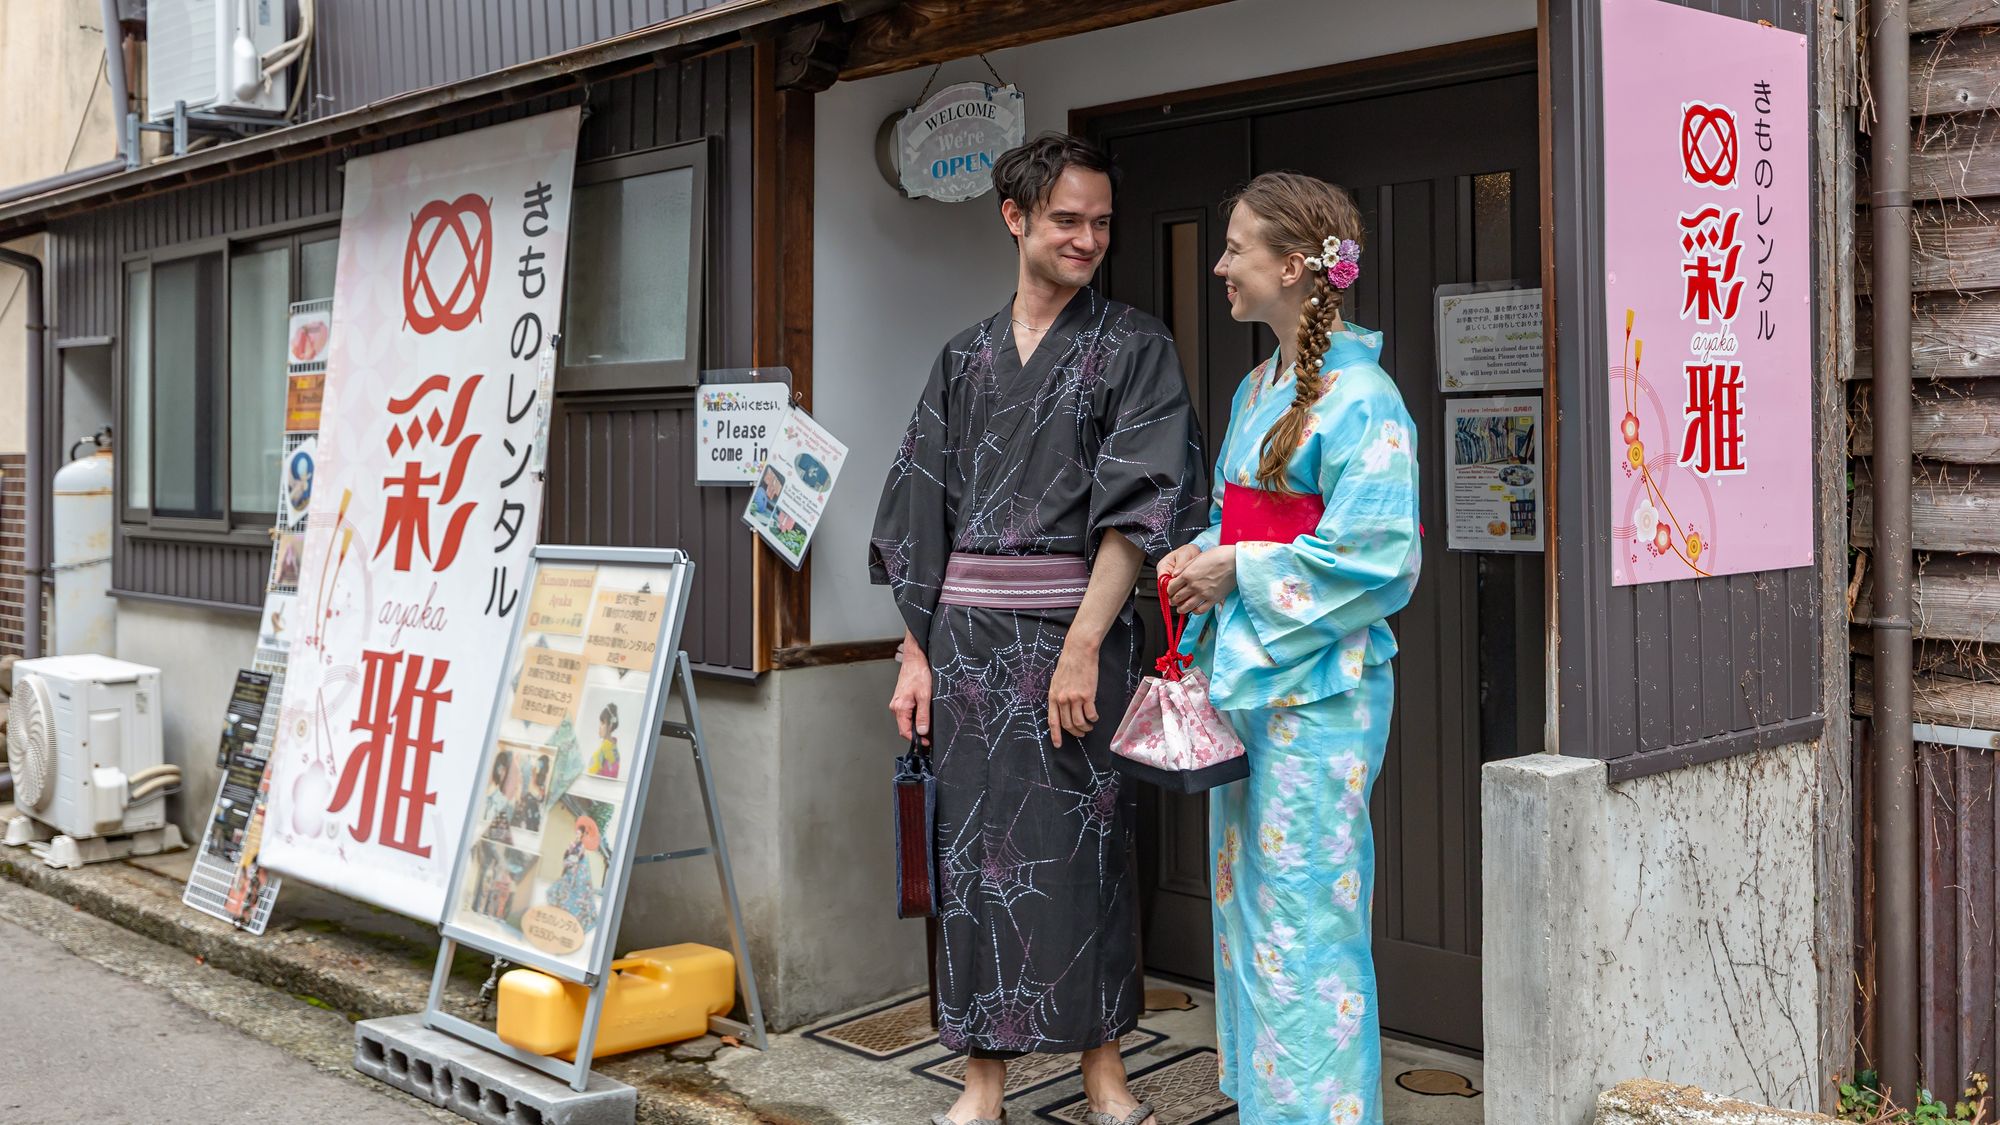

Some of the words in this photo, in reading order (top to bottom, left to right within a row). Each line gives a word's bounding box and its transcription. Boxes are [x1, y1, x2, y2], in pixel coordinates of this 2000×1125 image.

[925, 102, 997, 132] WELCOME
[937, 130, 985, 151] We're
[931, 150, 994, 180] OPEN
[1754, 80, 1776, 342] きものレンタル
[1692, 323, 1737, 363] ayaka
[484, 181, 552, 618] きものレンタル
[717, 420, 766, 439] Please
[711, 447, 743, 461] come
[754, 442, 768, 461] in
[378, 581, 448, 648] ayaka
